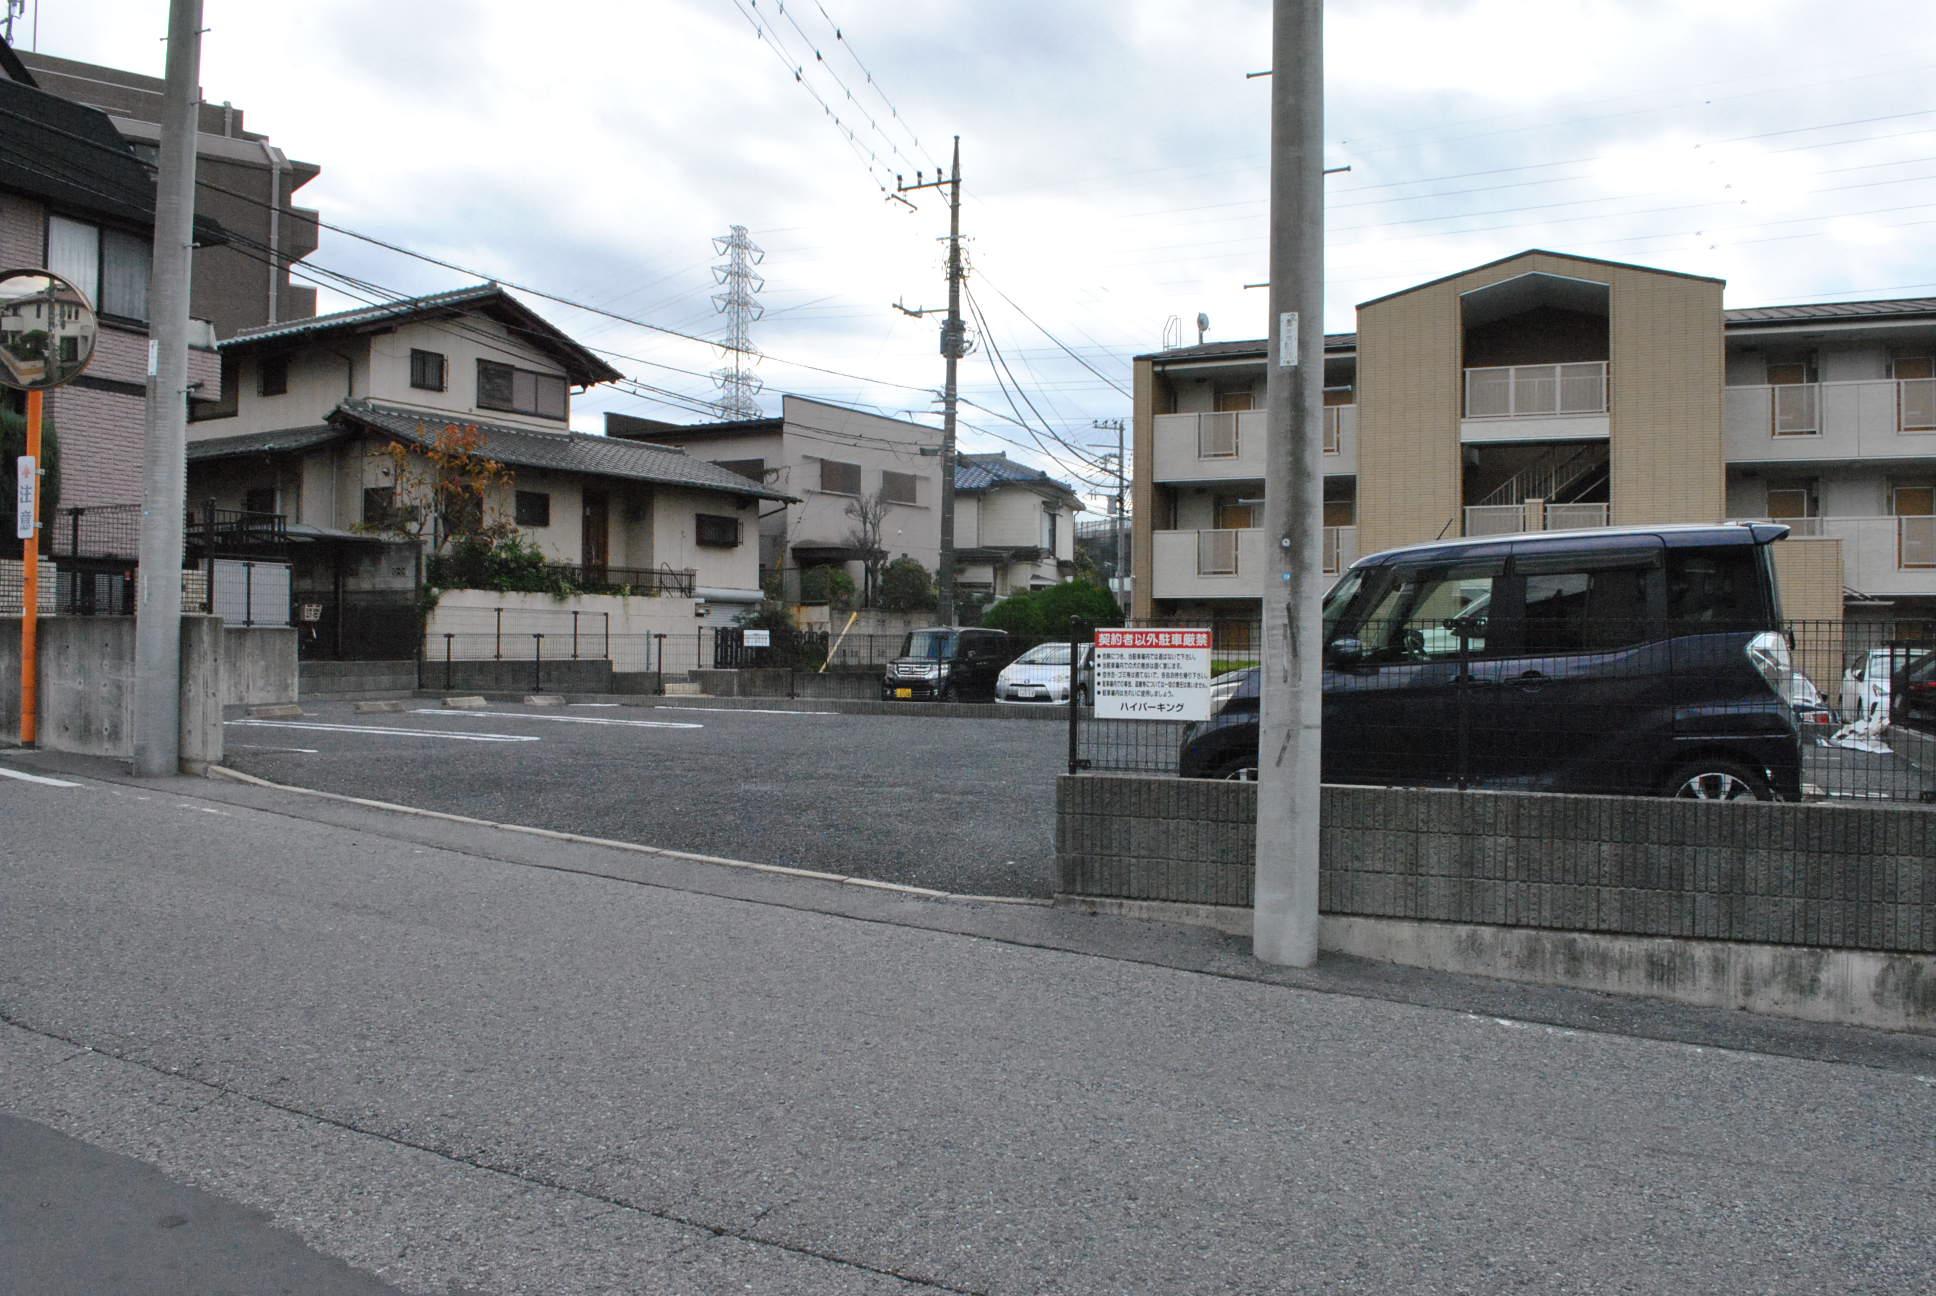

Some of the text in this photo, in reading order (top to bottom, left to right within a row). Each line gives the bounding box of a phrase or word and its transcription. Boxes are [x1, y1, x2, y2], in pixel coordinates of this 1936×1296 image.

[20, 483, 32, 530] 注意
[1098, 632, 1208, 647] 契約者以外駐車厳禁
